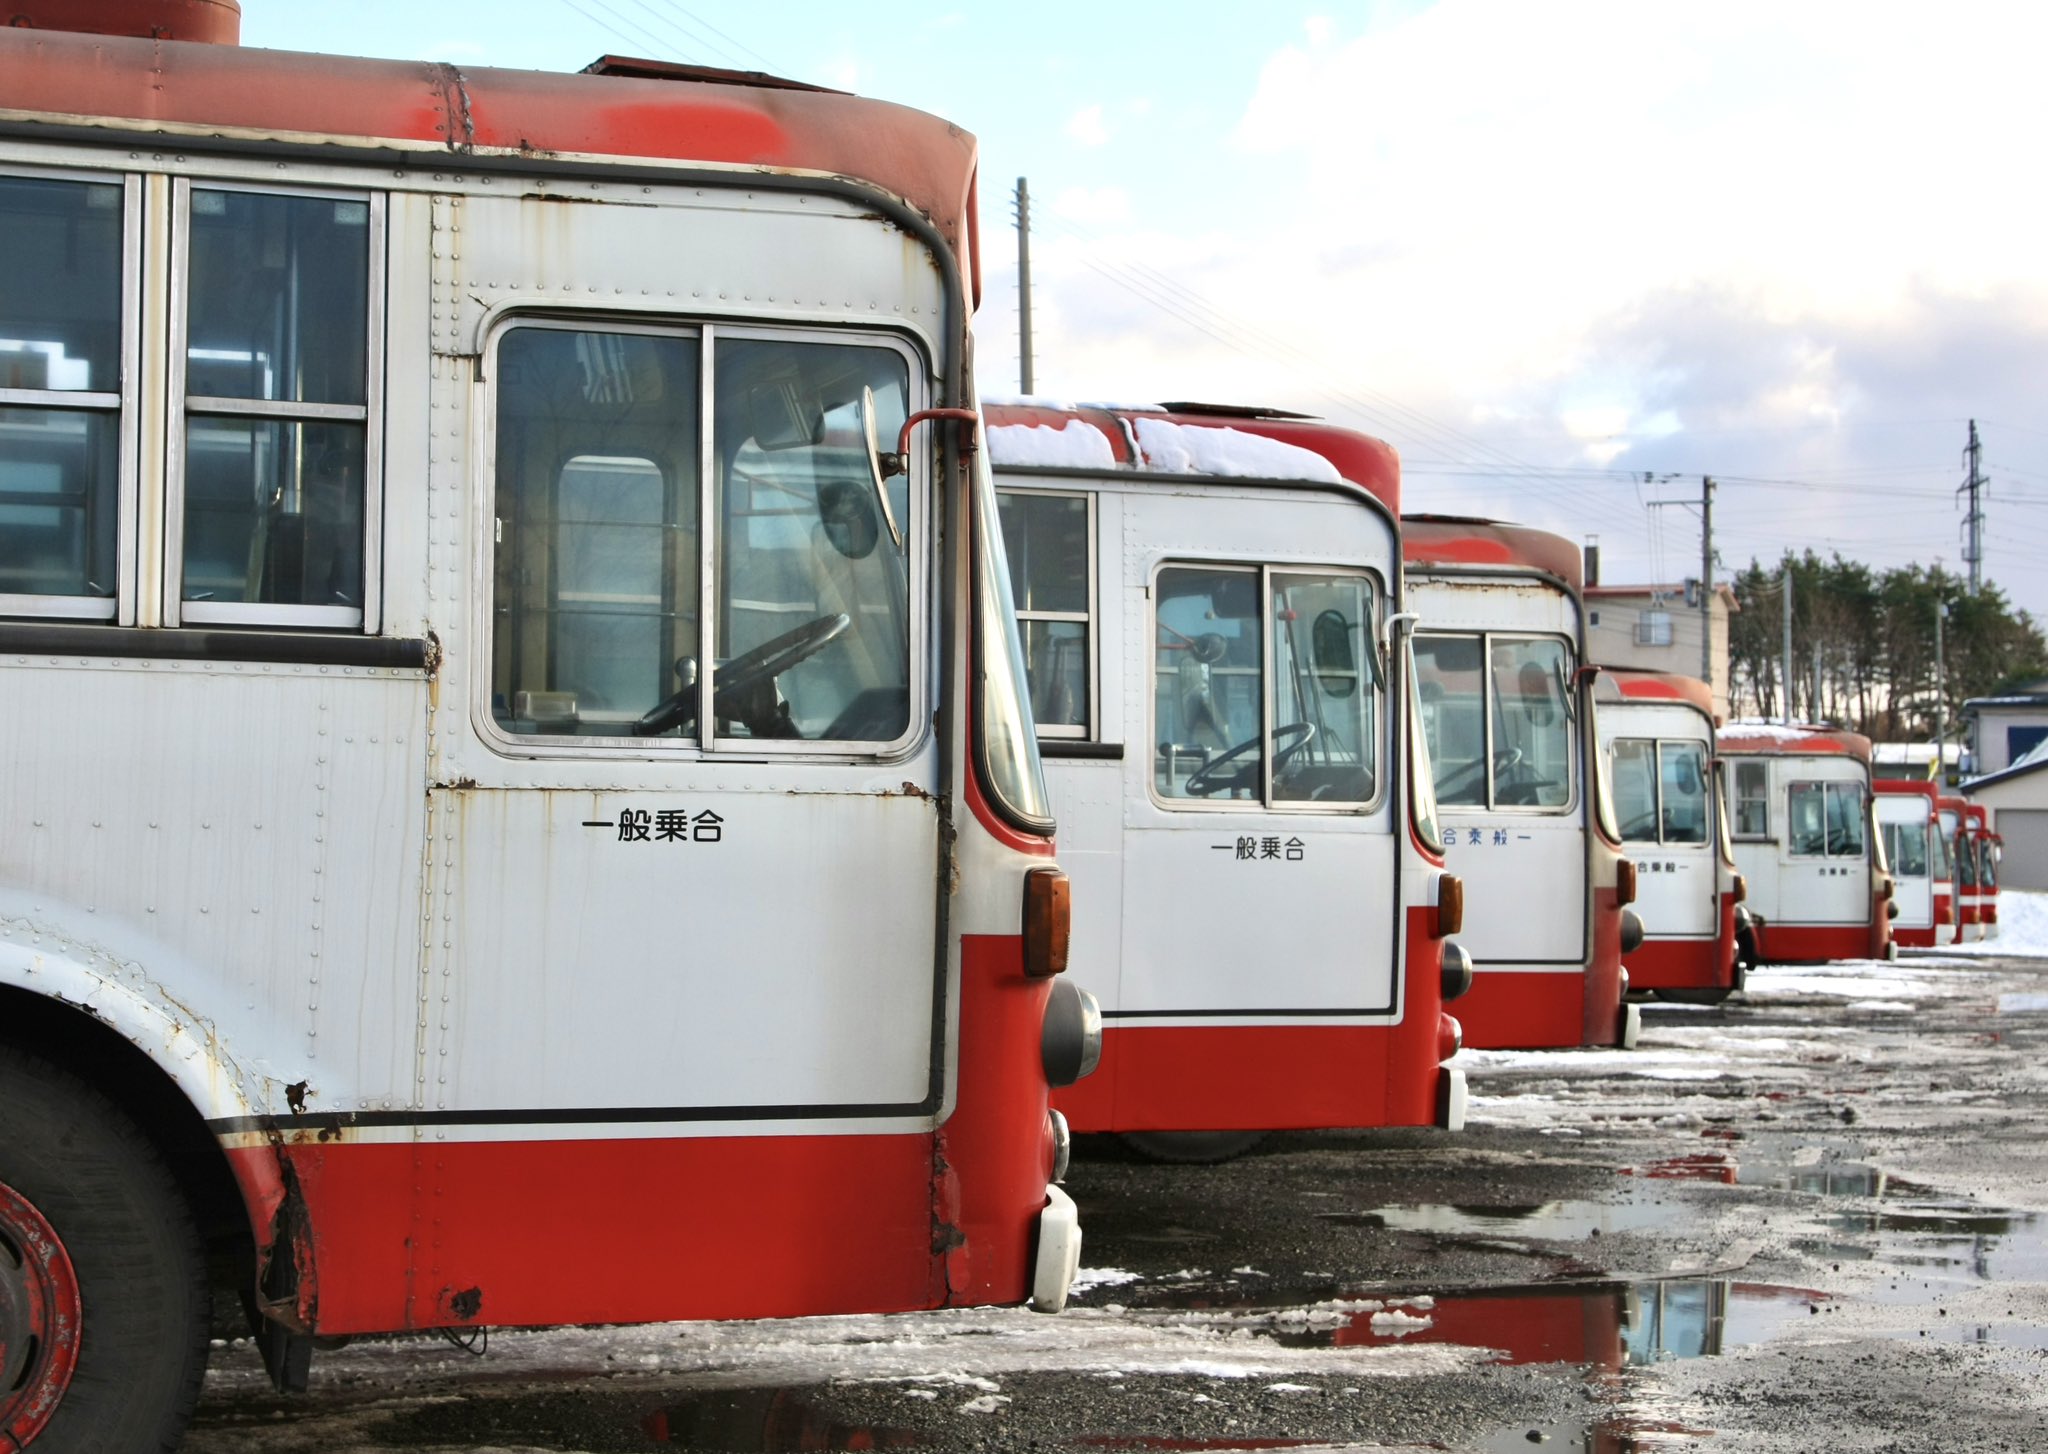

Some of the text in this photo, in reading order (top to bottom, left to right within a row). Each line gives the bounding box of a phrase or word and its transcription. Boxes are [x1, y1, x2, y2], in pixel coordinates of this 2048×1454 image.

[582, 808, 724, 842] 一般乗合
[1211, 836, 1305, 860] 一般乗合
